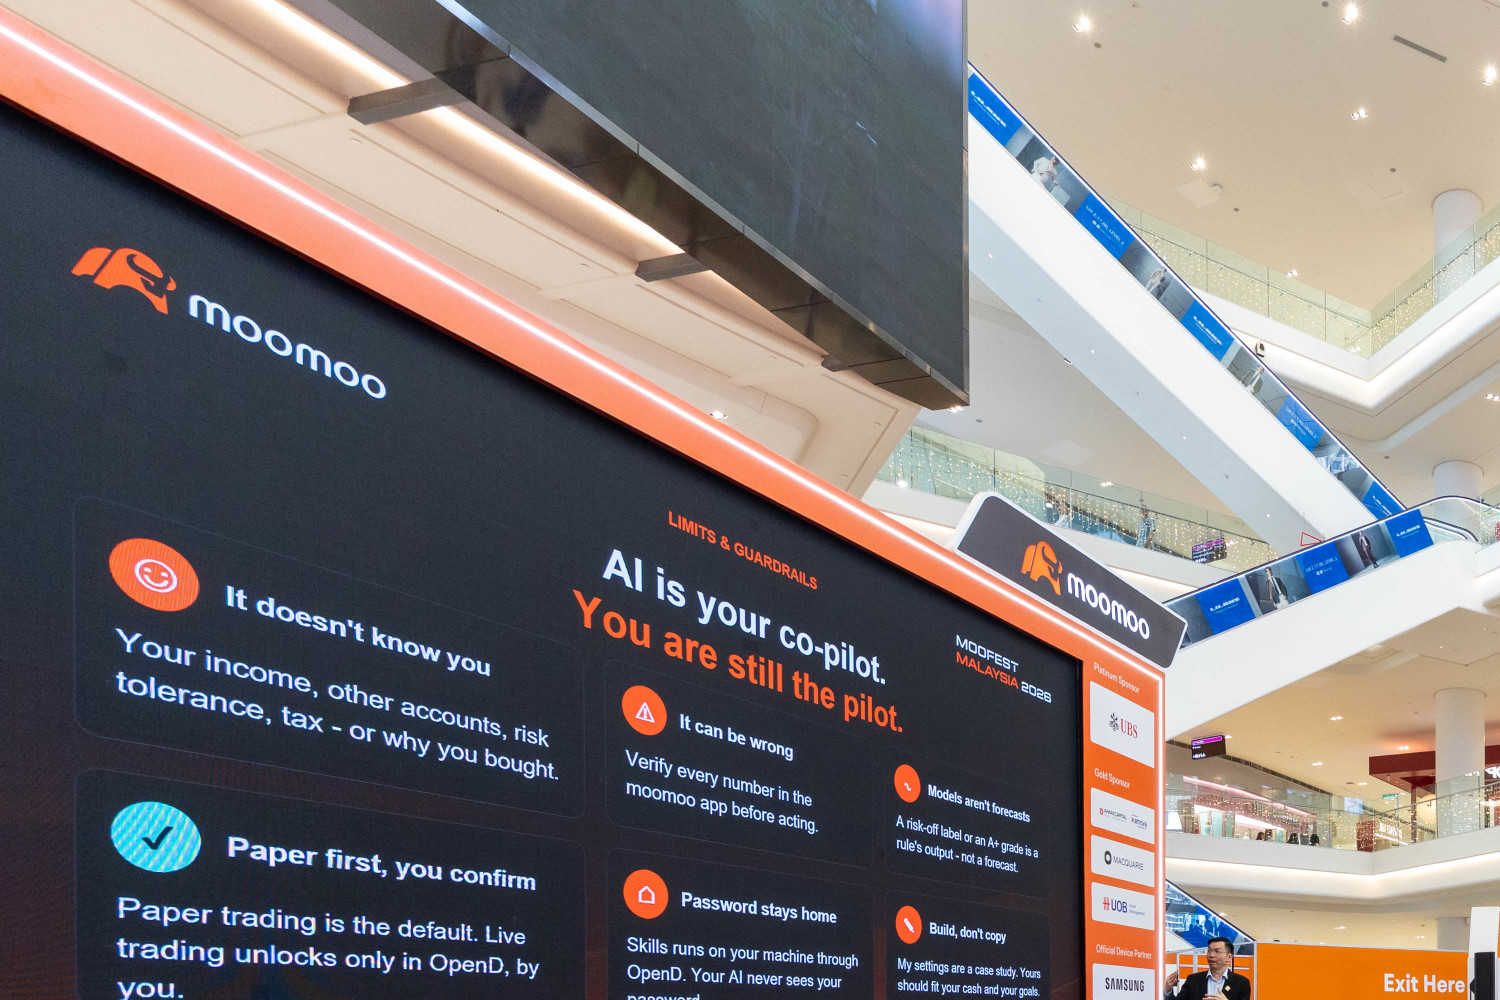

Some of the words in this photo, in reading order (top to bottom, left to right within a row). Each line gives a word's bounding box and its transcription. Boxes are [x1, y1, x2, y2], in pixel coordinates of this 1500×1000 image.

[188, 294, 387, 399] moomoo
[669, 511, 716, 544] LIMITS
[720, 536, 730, 551] &
[734, 542, 817, 589] GUARDRAILS
[602, 549, 643, 592] AI
[656, 567, 686, 607] is
[696, 591, 771, 639] your
[779, 625, 886, 685] co-pilot.
[1067, 572, 1150, 640] moomoo
[226, 585, 248, 611] It
[255, 597, 364, 642] doesn't
[371, 626, 441, 662] know
[446, 652, 490, 676] you
[573, 590, 650, 648] You
[664, 632, 717, 669] are
[728, 654, 783, 692] still
[792, 671, 835, 709] the
[844, 693, 902, 732] pilot.
[956, 635, 1019, 673] MOOFEST
[115, 628, 197, 666] Your
[205, 649, 318, 698] income,
[328, 684, 394, 711] other
[400, 701, 507, 741] accounts,
[514, 725, 549, 747] risk
[956, 651, 1019, 689] MALAYSIA
[1021, 681, 1052, 703] 2026
[1093, 661, 1118, 682] Platinum
[1118, 675, 1140, 693] Sponsor
[680, 714, 691, 731] It
[694, 722, 723, 739] can
[727, 727, 746, 745] be
[749, 736, 793, 761] wrong
[1120, 718, 1138, 739] UBS
[1094, 767, 1108, 781] Gold
[1108, 773, 1131, 789] Sponsor
[928, 784, 963, 804] Models
[964, 797, 991, 812] aren't
[992, 802, 1030, 823] forecasts
[227, 836, 318, 867] Paper
[324, 848, 387, 878] first,
[394, 861, 443, 880] you
[449, 868, 536, 891] confirm
[1113, 855, 1144, 871] MACQUARIE
[681, 891, 757, 915] Password
[761, 903, 798, 921] stays
[801, 906, 837, 923] home
[1111, 898, 1128, 914] UOB
[929, 922, 958, 939] Build,
[960, 926, 984, 940] don't
[985, 932, 1007, 944] copy
[1096, 943, 1115, 956] Official
[1116, 946, 1133, 958] Device
[1134, 949, 1152, 960] Partner
[116, 938, 224, 968] trading
[234, 945, 338, 967] unlocks
[345, 950, 395, 974] only
[402, 952, 422, 971] in
[429, 953, 509, 977] OpenD,
[516, 958, 540, 980] by
[1105, 977, 1144, 992] SAMSUNG
[1383, 973, 1418, 992] Exit
[1423, 974, 1466, 993] Here
